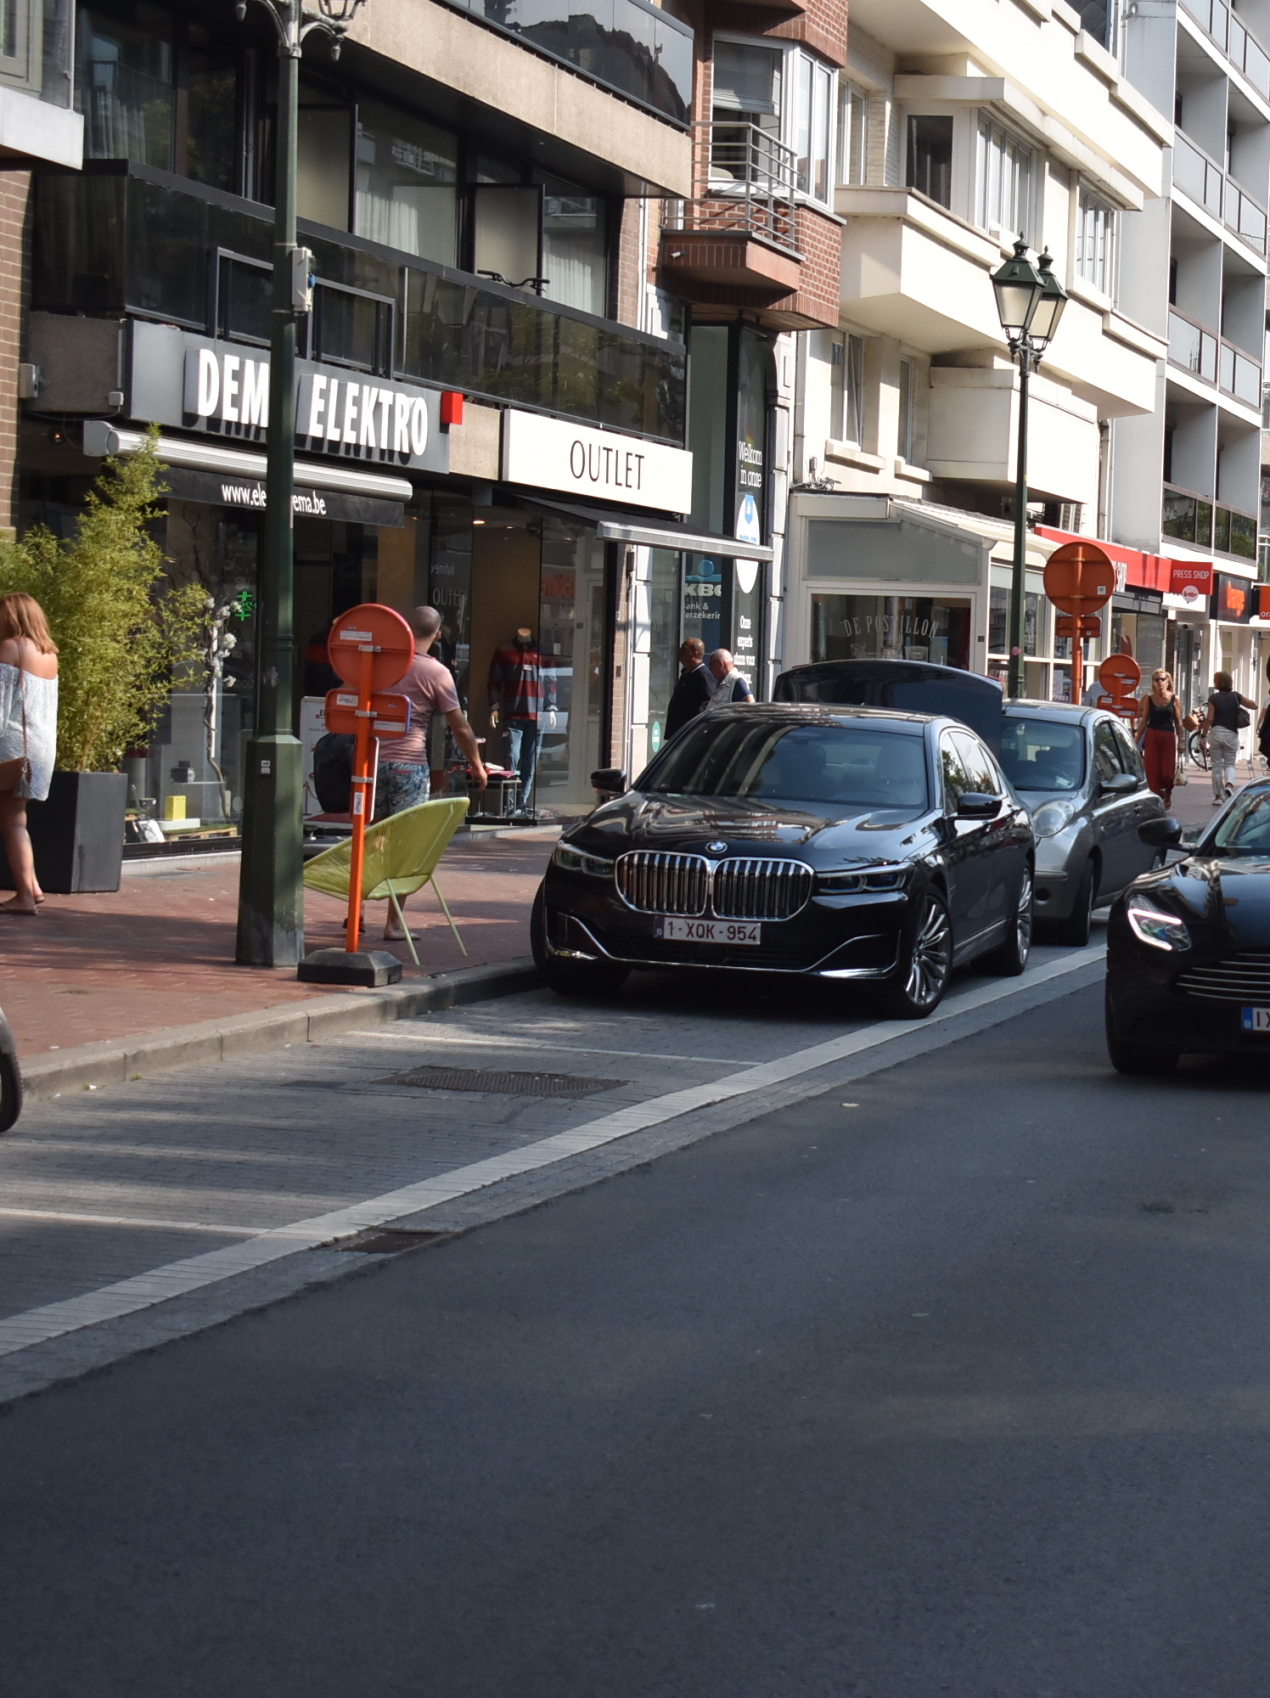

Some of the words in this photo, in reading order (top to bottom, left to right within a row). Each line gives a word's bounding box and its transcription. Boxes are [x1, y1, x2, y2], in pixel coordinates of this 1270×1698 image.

[197, 349, 269, 428] DEM
[308, 373, 428, 456] ELEKTRO
[738, 441, 763, 466] Welkom
[570, 440, 645, 490] OUTLET
[740, 464, 747, 484] in
[221, 483, 327, 515] www.eleema.be
[1173, 569, 1191, 579] PRESS
[1193, 570, 1210, 580] SHOP
[685, 602, 698, 610] ank
[843, 617, 861, 637] DE
